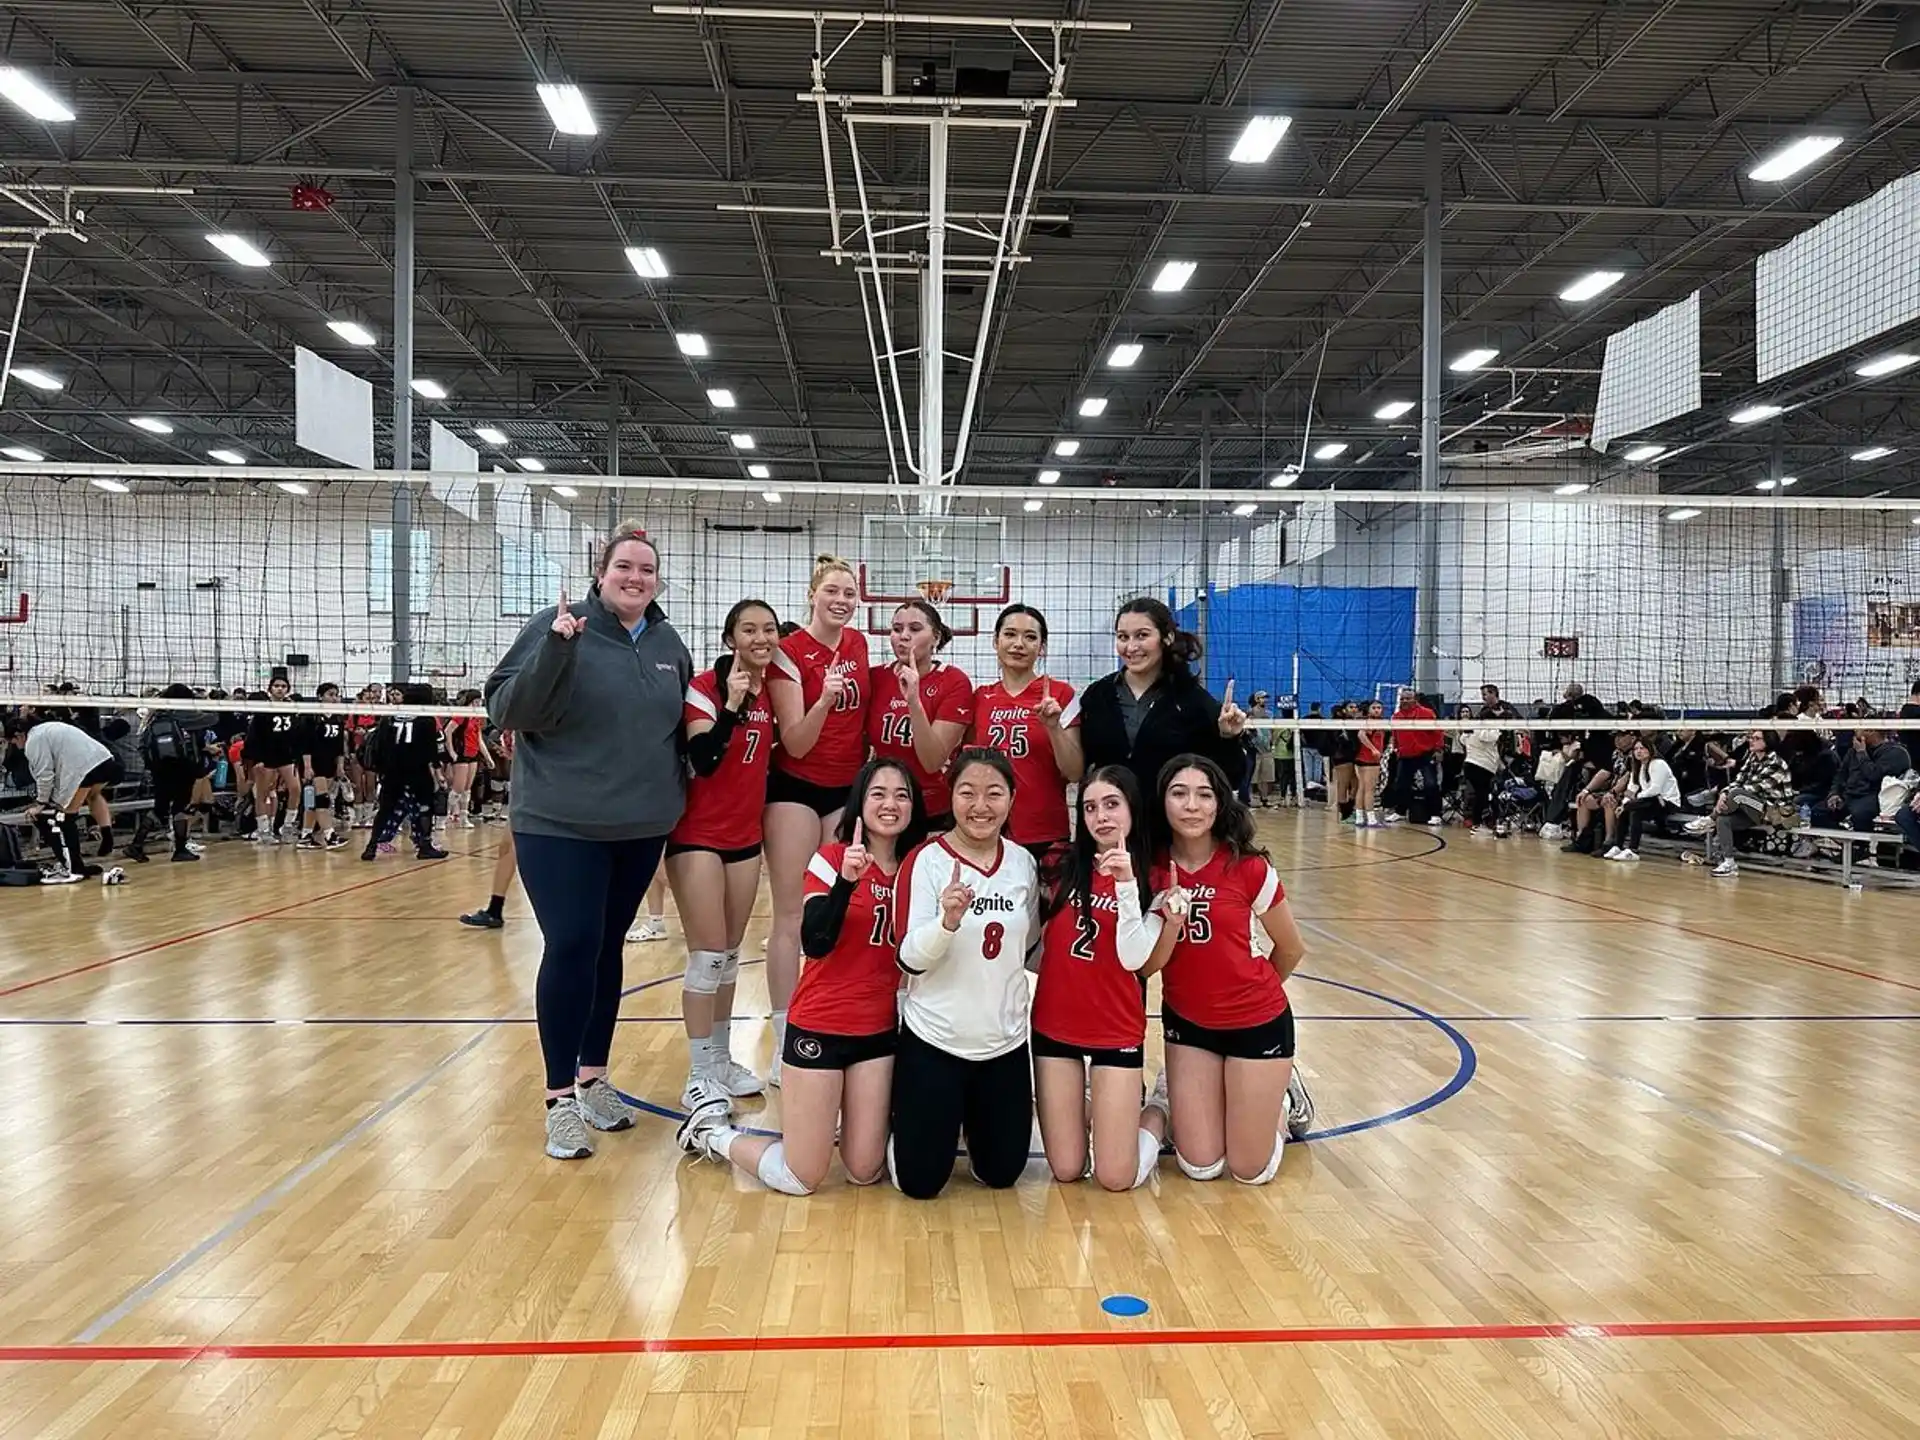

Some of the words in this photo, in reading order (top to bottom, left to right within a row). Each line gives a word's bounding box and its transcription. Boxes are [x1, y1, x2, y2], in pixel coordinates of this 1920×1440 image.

[823, 659, 857, 678] inite
[272, 716, 292, 732] 23
[747, 707, 770, 723] nite
[990, 705, 1031, 723] ignite
[393, 722, 414, 744] 71
[881, 711, 914, 747] 14
[742, 729, 760, 764] 7
[987, 724, 1030, 759] 25
[871, 878, 892, 900] ign
[982, 921, 1005, 960] 8
[1070, 915, 1100, 962] 2
